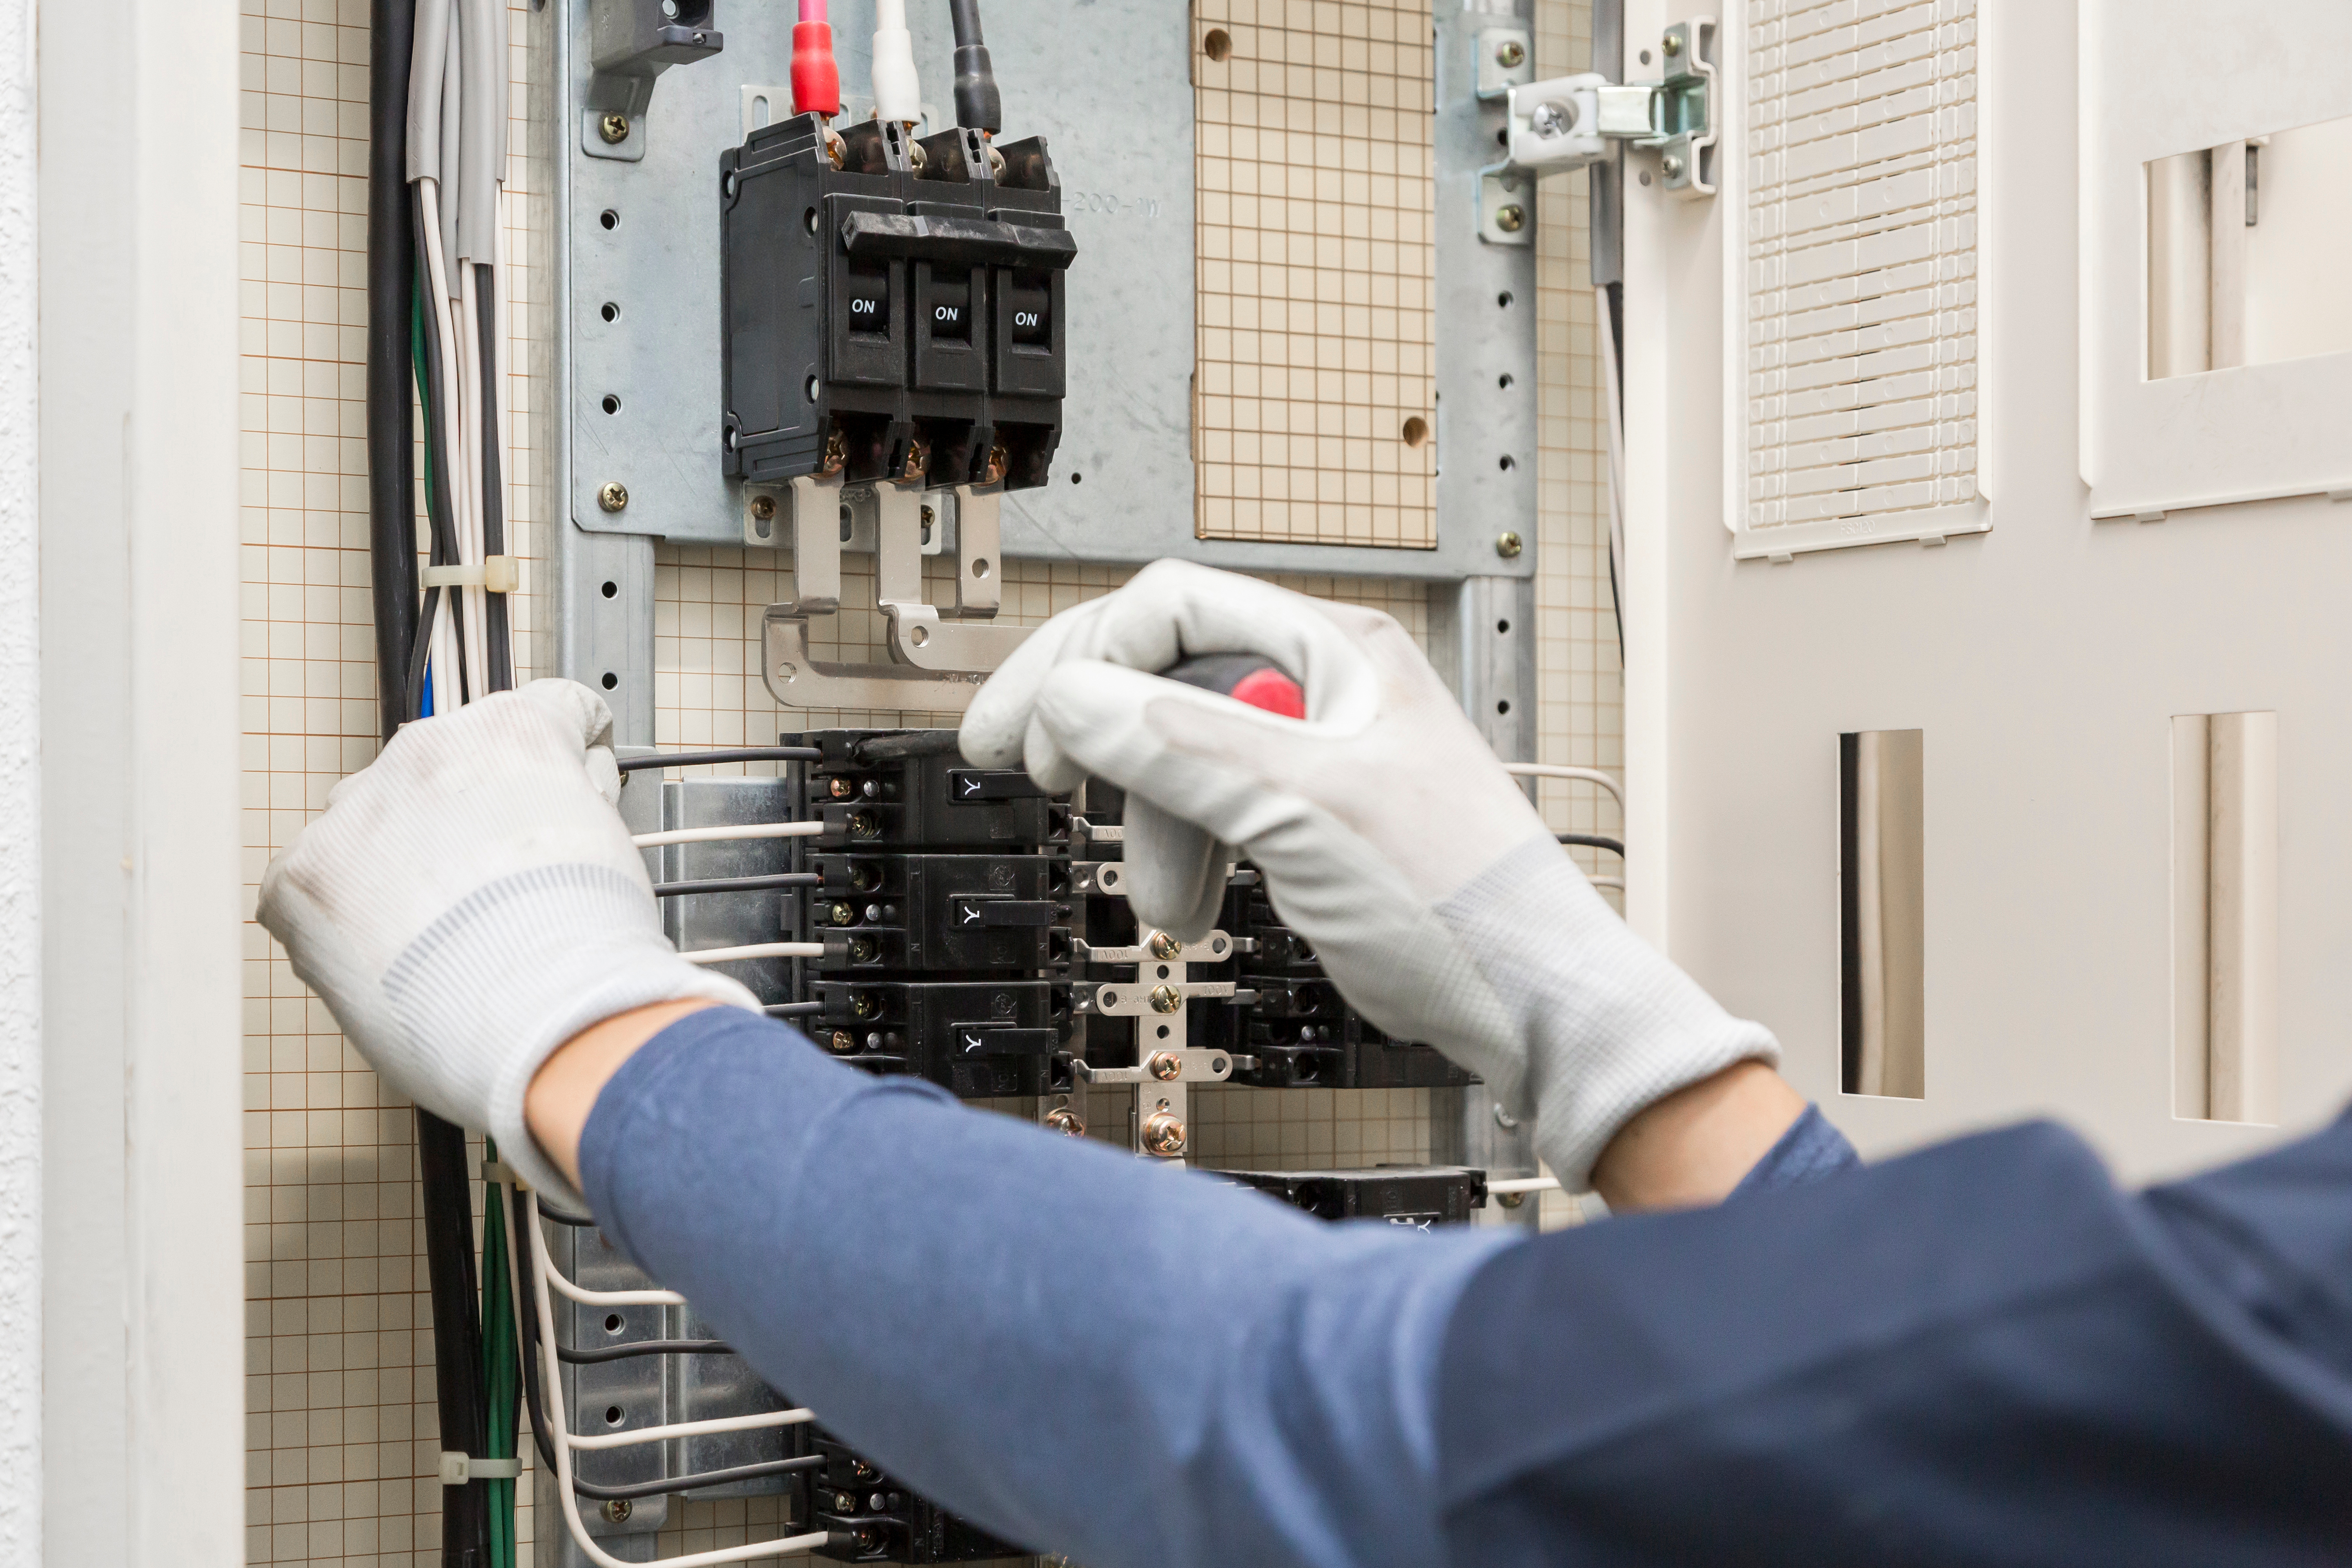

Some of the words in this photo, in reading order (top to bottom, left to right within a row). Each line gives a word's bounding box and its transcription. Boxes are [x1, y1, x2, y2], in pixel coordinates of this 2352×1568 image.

[853, 299, 874, 313] ON
[936, 307, 958, 320] ON
[1016, 312, 1037, 326] ON
